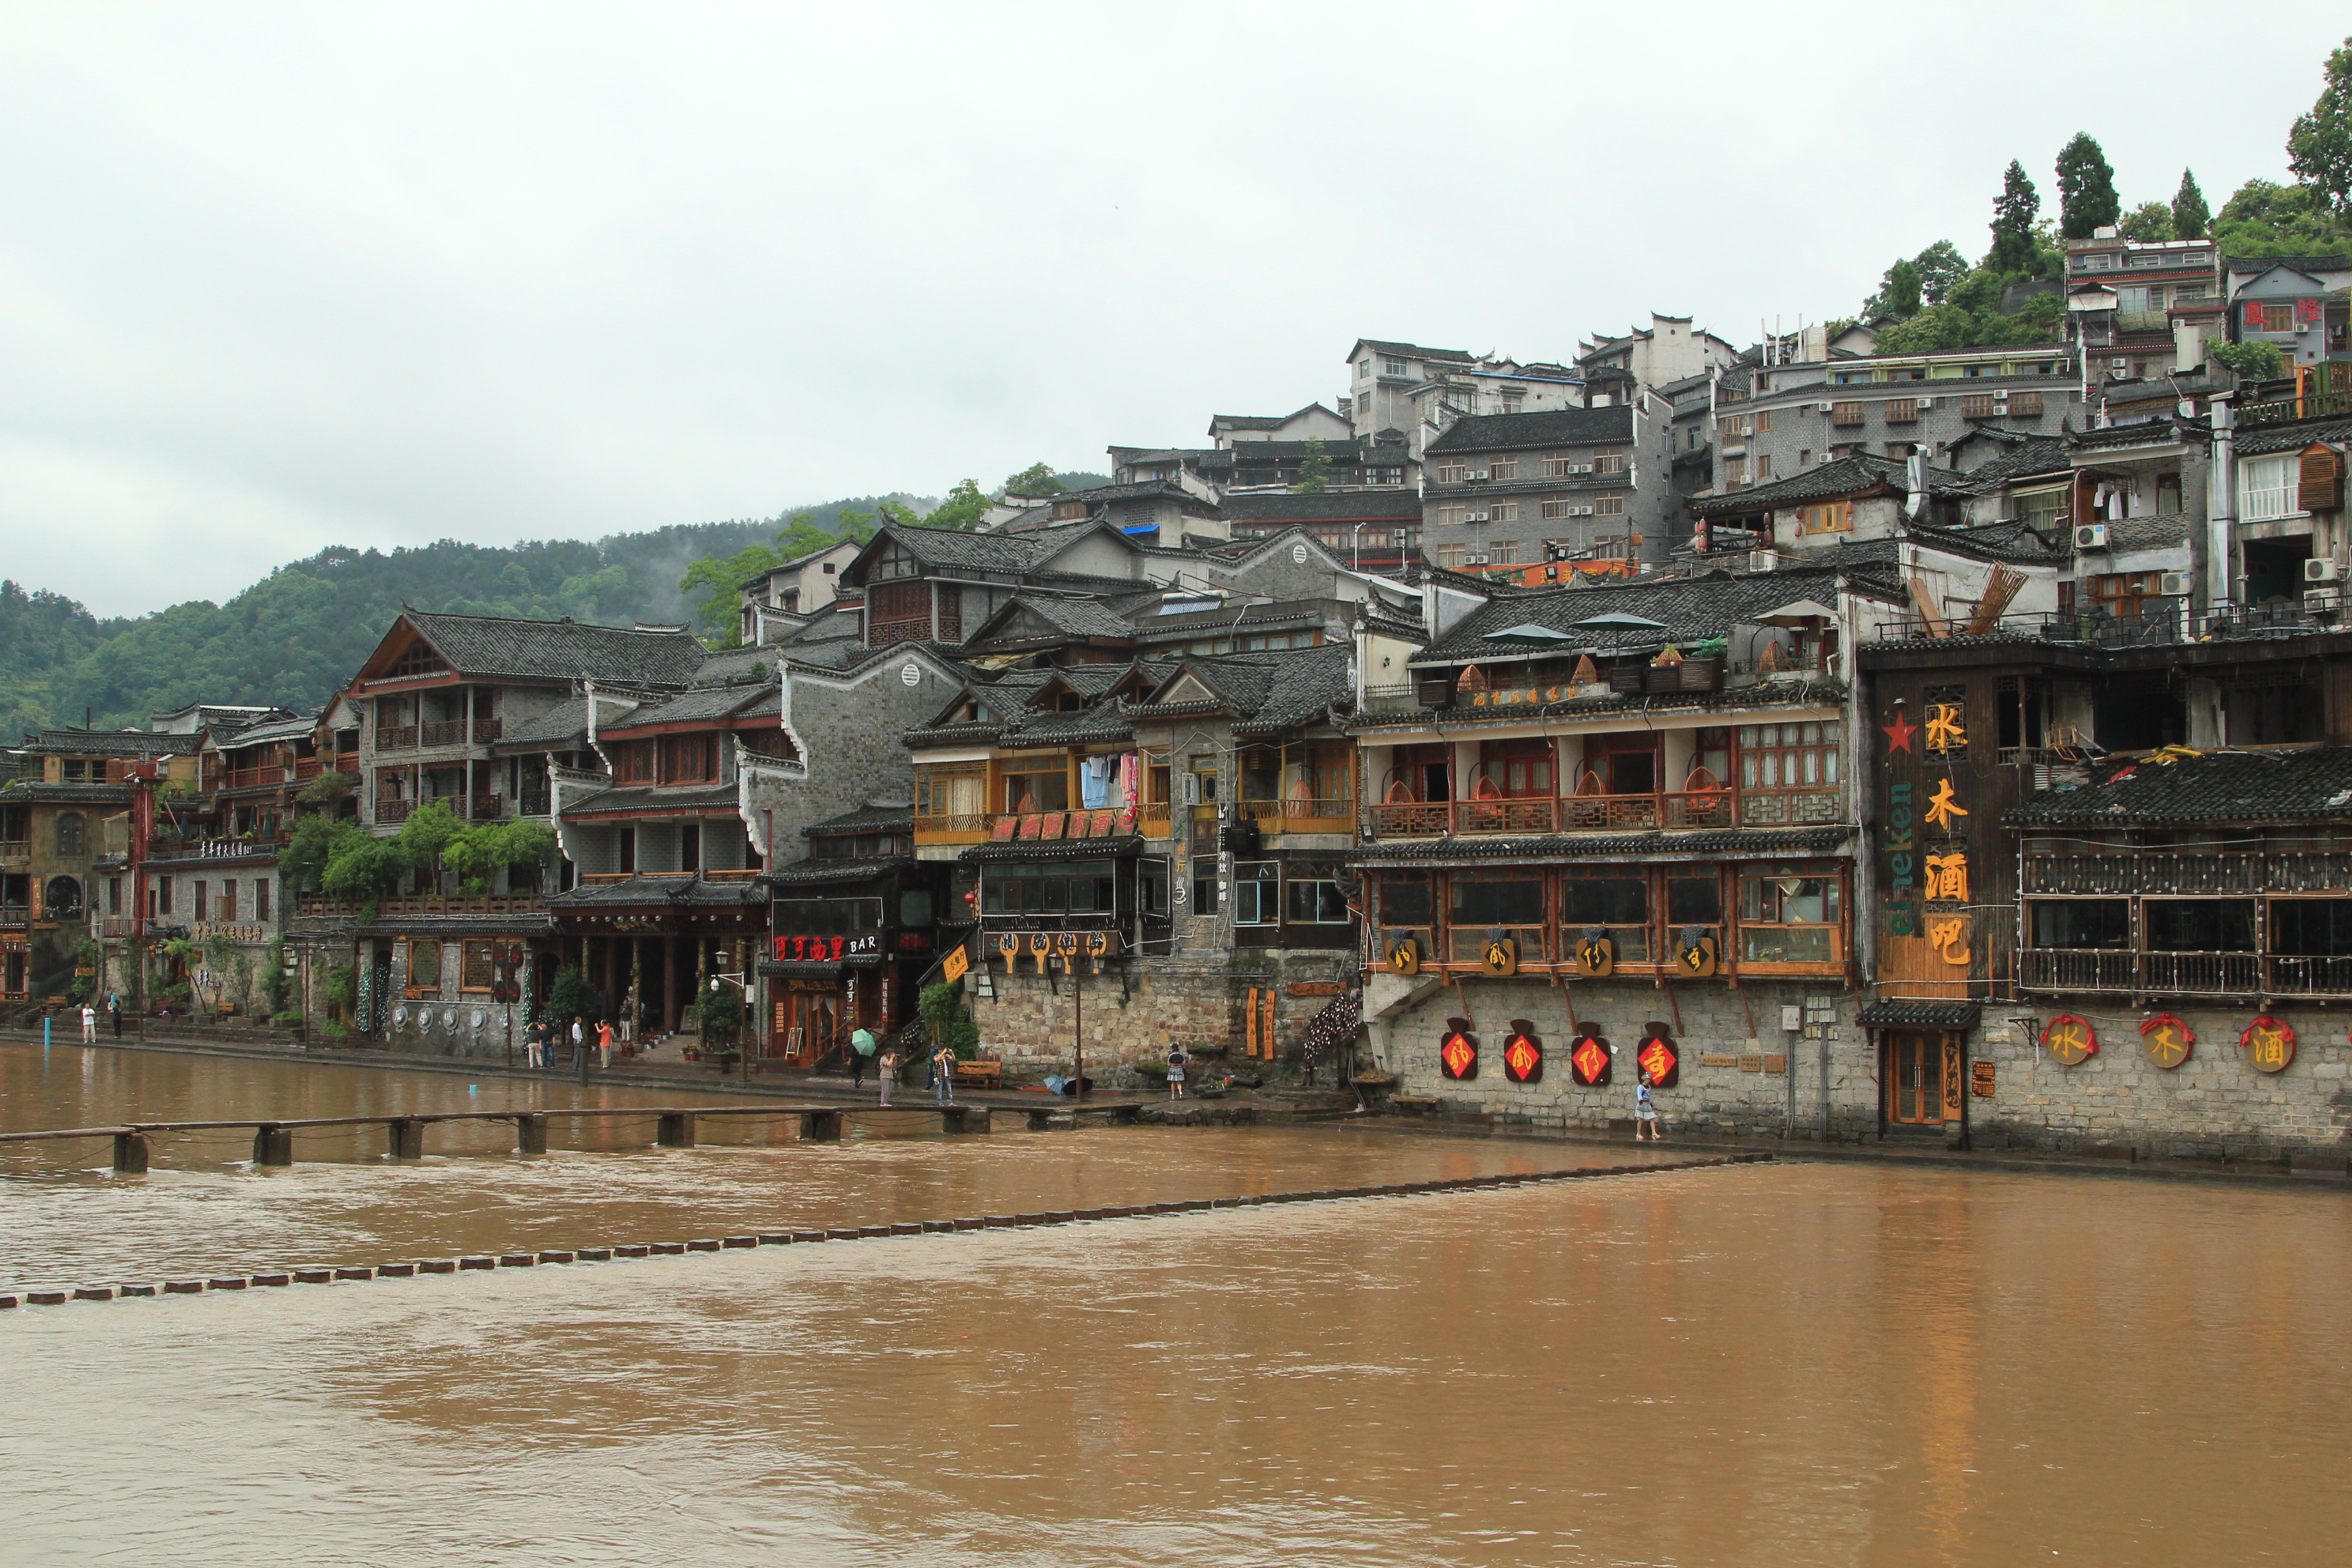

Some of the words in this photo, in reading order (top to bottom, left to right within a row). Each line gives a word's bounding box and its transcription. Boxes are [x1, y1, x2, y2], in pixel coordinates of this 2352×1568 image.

[1925, 704, 1971, 965] 水木酒吧
[774, 936, 845, 962] 可可西里
[850, 936, 877, 953] BAR
[2051, 1024, 2285, 1066] 水木酒
